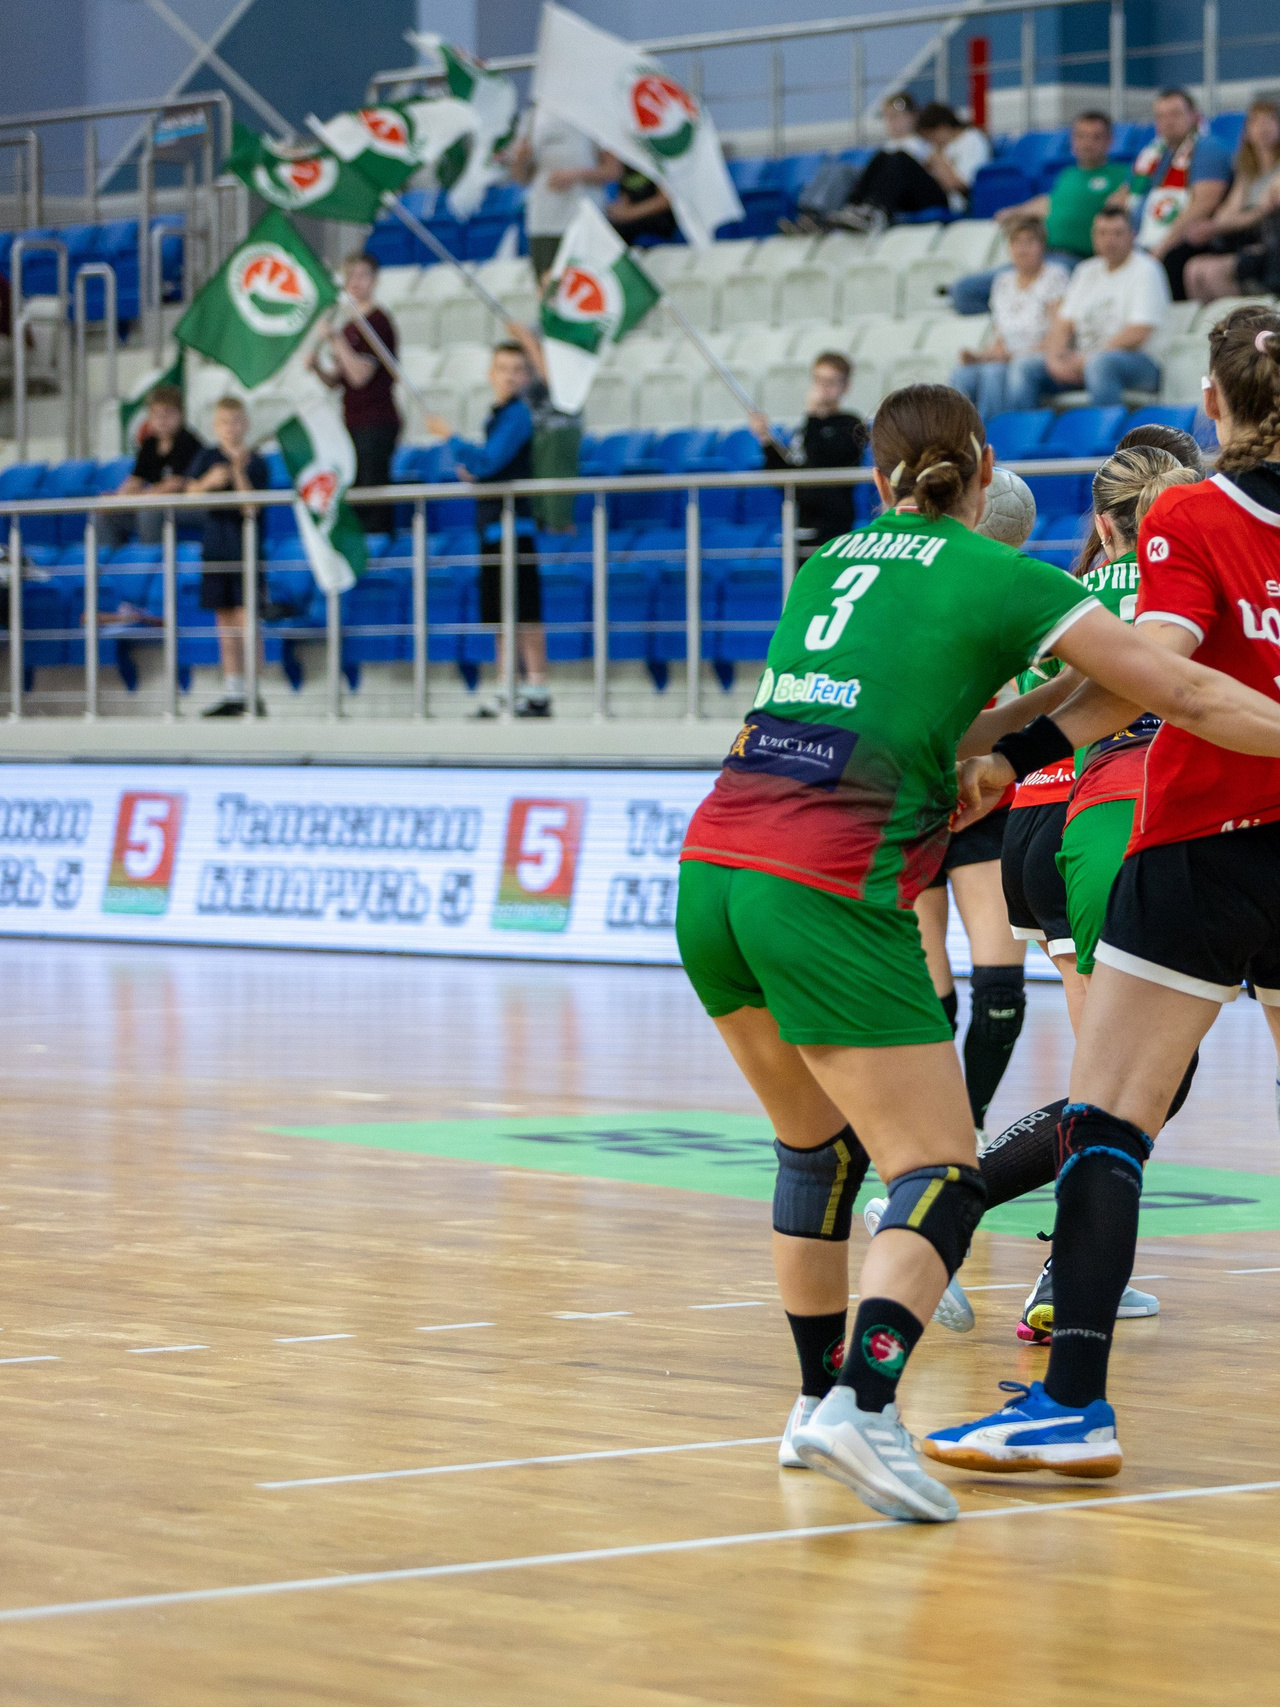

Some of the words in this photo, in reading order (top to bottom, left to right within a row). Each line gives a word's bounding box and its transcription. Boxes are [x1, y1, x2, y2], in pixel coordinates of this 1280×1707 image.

[820, 532, 948, 567] УМАНЕЦ
[1082, 563, 1140, 592] СУПР
[803, 563, 881, 651] 3
[773, 672, 861, 708] BelFert
[124, 799, 170, 880] 5
[215, 792, 483, 851] Телеканал
[516, 805, 568, 893] 5
[196, 859, 429, 923] БЕЛАРУСЬ
[440, 869, 474, 926] 5
